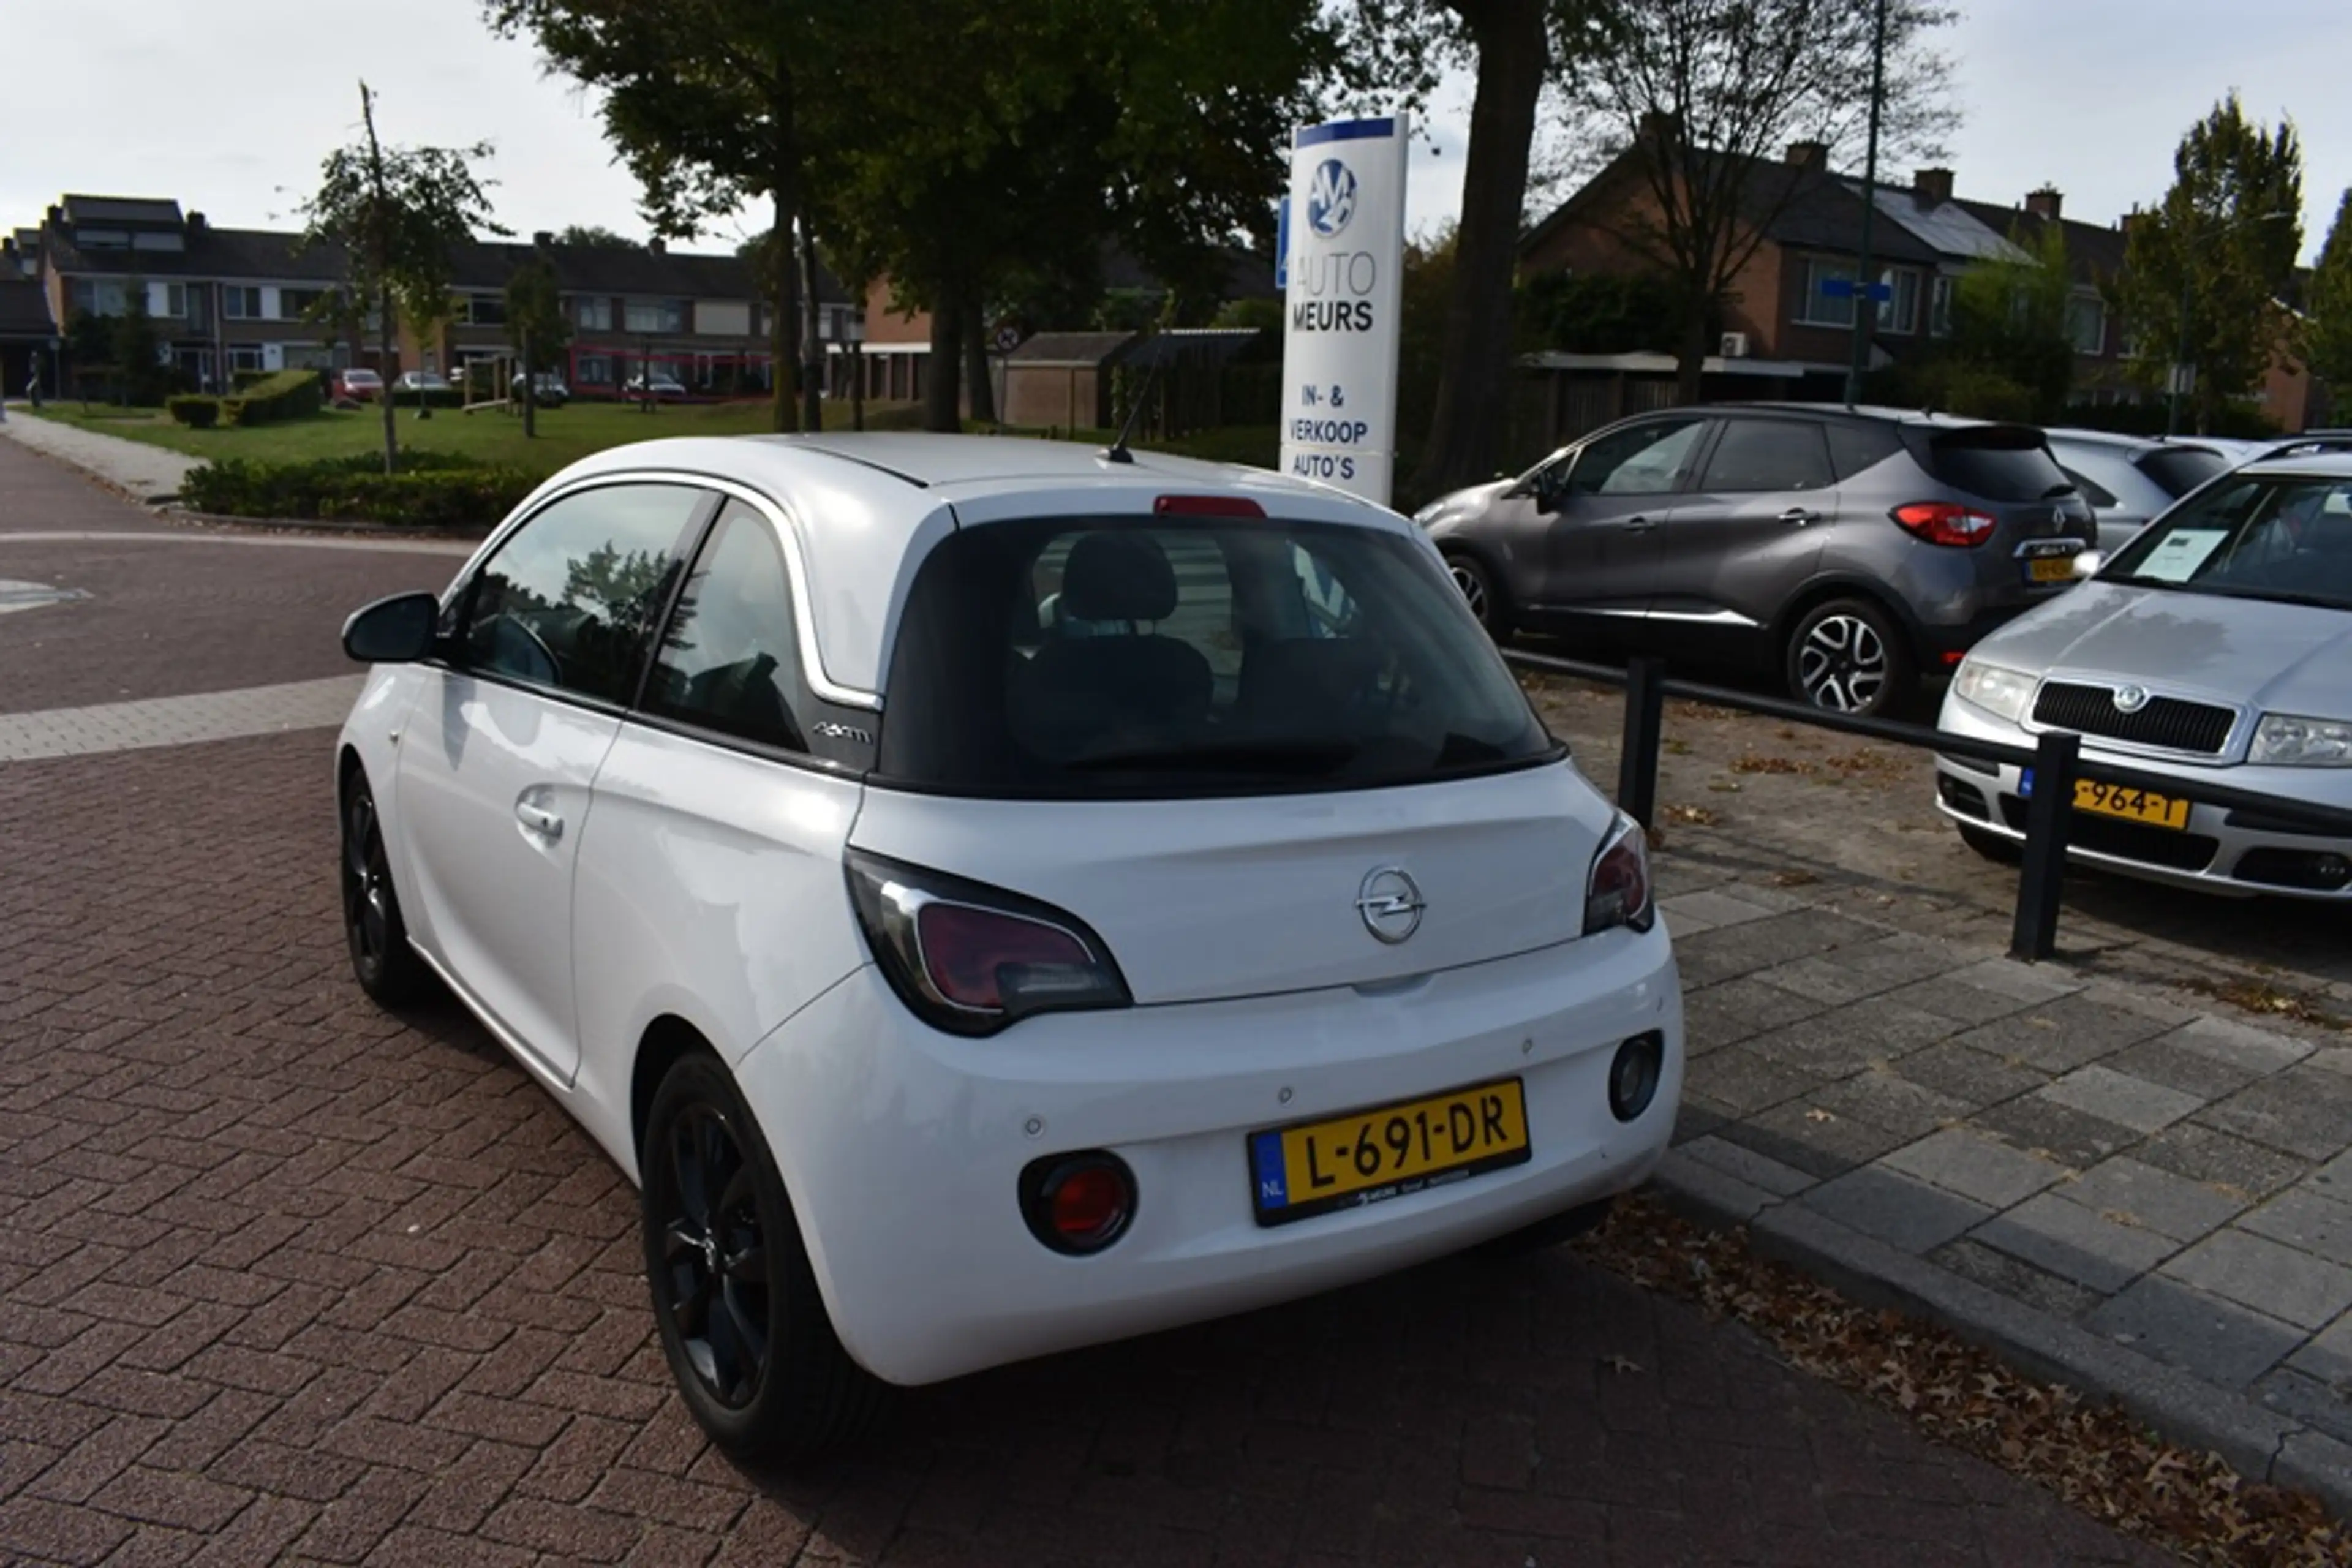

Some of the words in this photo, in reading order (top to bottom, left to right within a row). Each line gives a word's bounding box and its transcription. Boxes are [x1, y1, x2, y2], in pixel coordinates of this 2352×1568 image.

[1297, 251, 1376, 295] AUTO
[1292, 301, 1374, 331] MEURS
[1302, 385, 1323, 405] IN-
[1330, 385, 1344, 407] &
[1290, 418, 1368, 443] VERKOOP
[1293, 454, 1355, 479] AUTO'S
[1306, 1095, 1508, 1189] L-691-DR
[1262, 1181, 1283, 1198] NL
